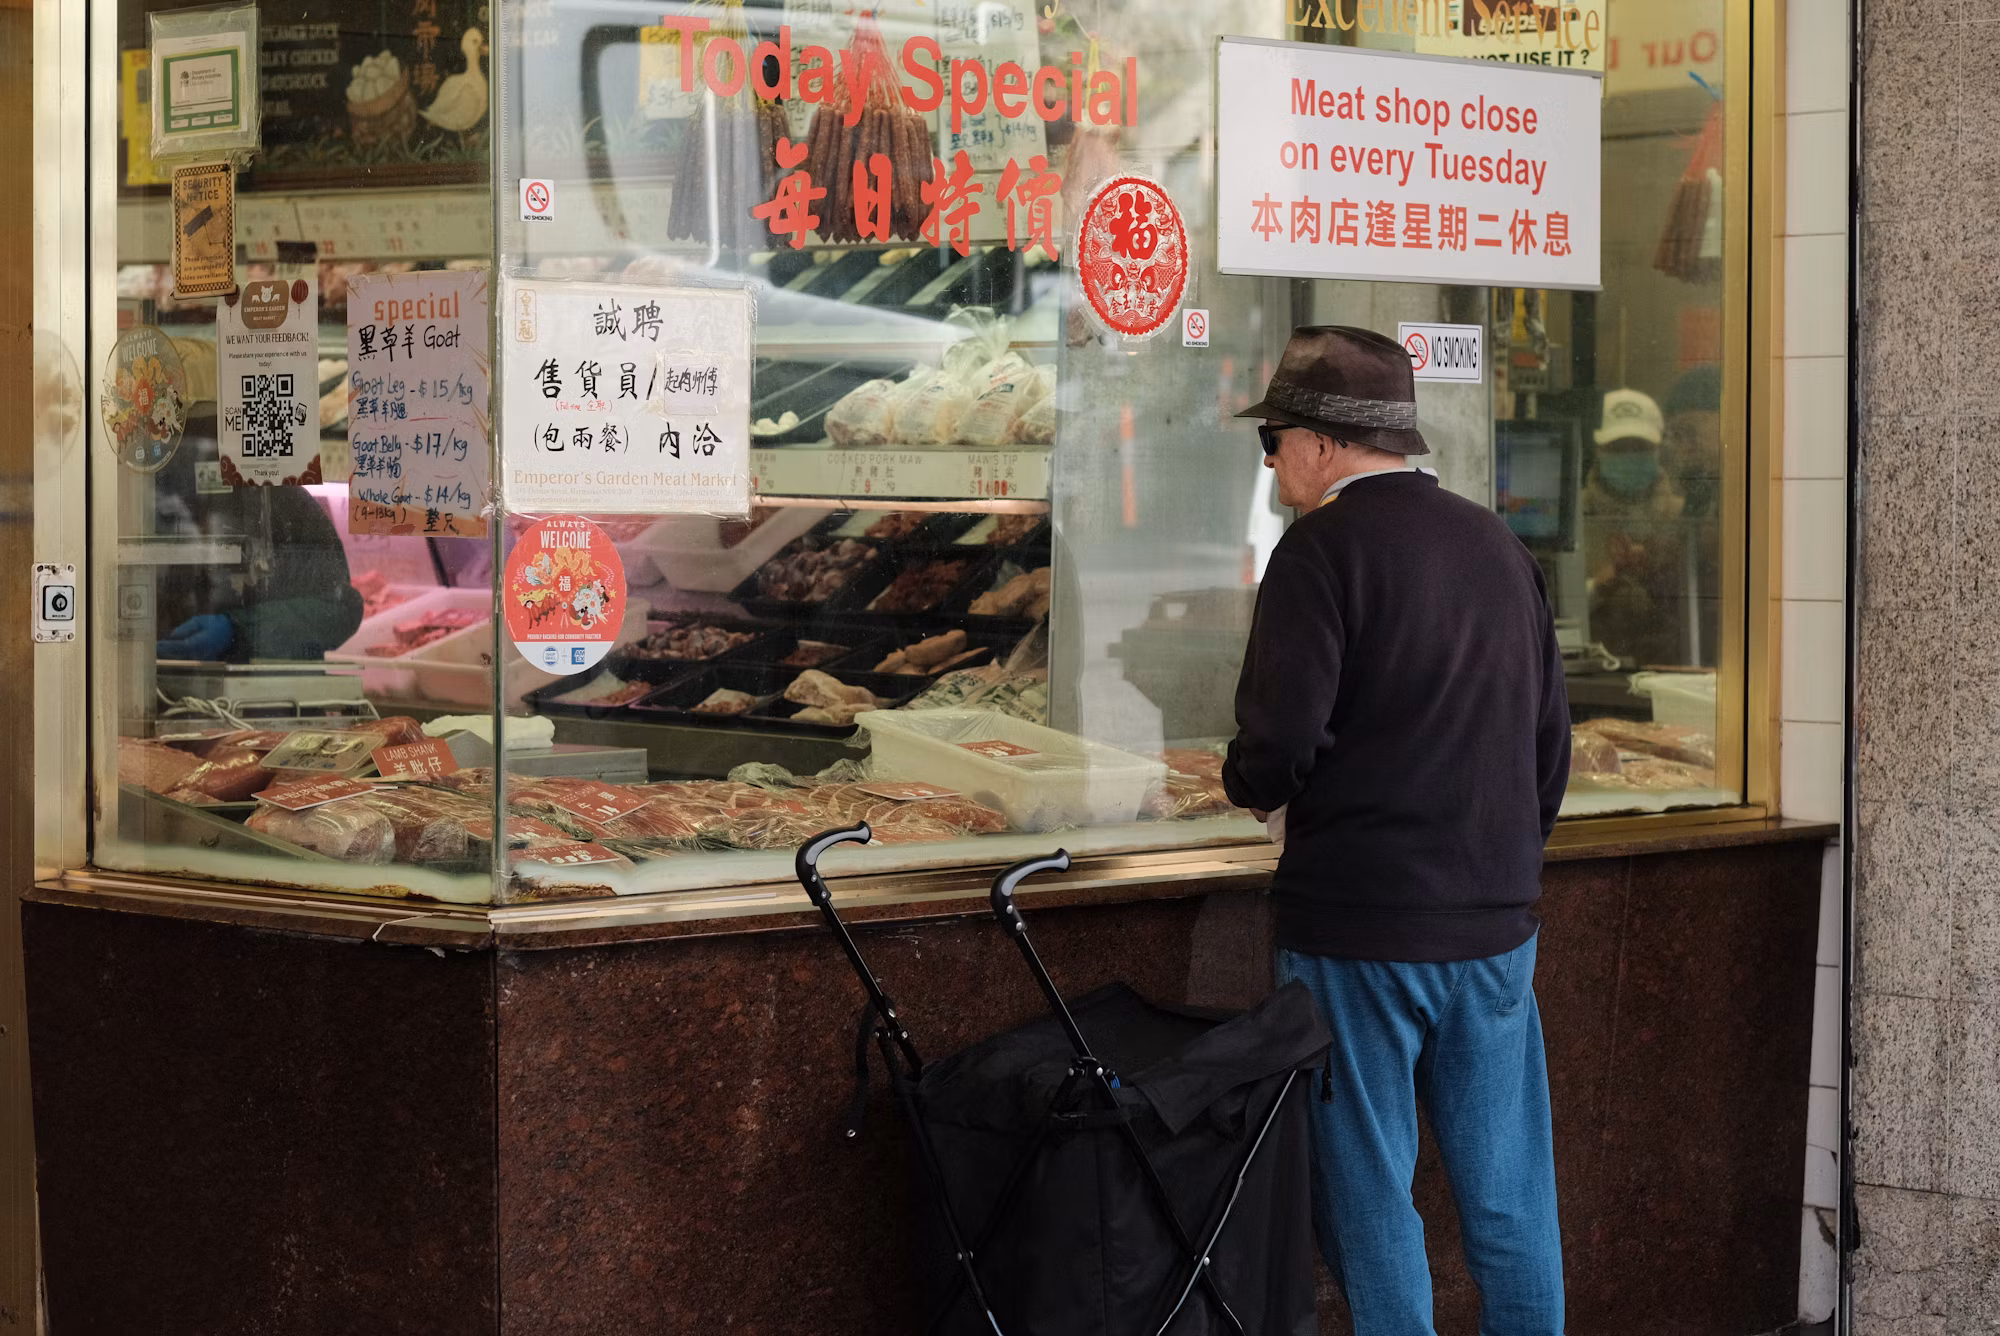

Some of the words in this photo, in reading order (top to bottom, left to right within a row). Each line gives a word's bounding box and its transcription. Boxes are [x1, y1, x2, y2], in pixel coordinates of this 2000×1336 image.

[1516, 52, 1552, 66] USE
[1558, 50, 1575, 66] IT
[1580, 49, 1590, 65] ?
[663, 14, 877, 127] Today
[901, 35, 1138, 134] Special
[1290, 77, 1365, 121] Meat
[1375, 87, 1450, 136] shop
[1461, 95, 1538, 135] close
[1280, 141, 1318, 170] on
[1330, 145, 1415, 187] every
[1424, 142, 1547, 195] Tuesday
[182, 176, 223, 190] SECURITY
[186, 189, 219, 202] NOTICE
[751, 137, 1063, 262] 每日特價
[1109, 189, 1158, 260] 福
[1251, 192, 1572, 257] 本肉店逢星期二休息
[374, 290, 459, 329] special
[593, 298, 665, 342] 誠聘
[226, 335, 236, 345] WE
[236, 334, 254, 345] WANT
[255, 333, 271, 344] YOUR
[272, 332, 309, 343] FEEDBACK!
[423, 324, 461, 350] Goat
[264, 351, 289, 359] experience
[1431, 336, 1442, 368] NO
[1444, 336, 1477, 369] SMOKING
[352, 370, 384, 396] Goat
[387, 372, 405, 401] Leg
[225, 407, 242, 415] SCAN
[352, 432, 379, 456] Goat
[379, 434, 402, 461] Belly
[868, 455, 896, 465] PORK
[899, 455, 922, 465] MAW
[1003, 454, 1018, 465] TIP
[513, 469, 592, 488] Emperor's
[596, 471, 649, 486] Garden
[653, 472, 687, 487] Meat
[358, 488, 391, 505] Whole
[391, 486, 413, 506] Goat
[546, 520, 586, 528] ALWAYS
[540, 530, 592, 549] WELCOME
[558, 575, 571, 592] 福
[384, 747, 409, 762] LAMB
[409, 743, 438, 758] SHANK
